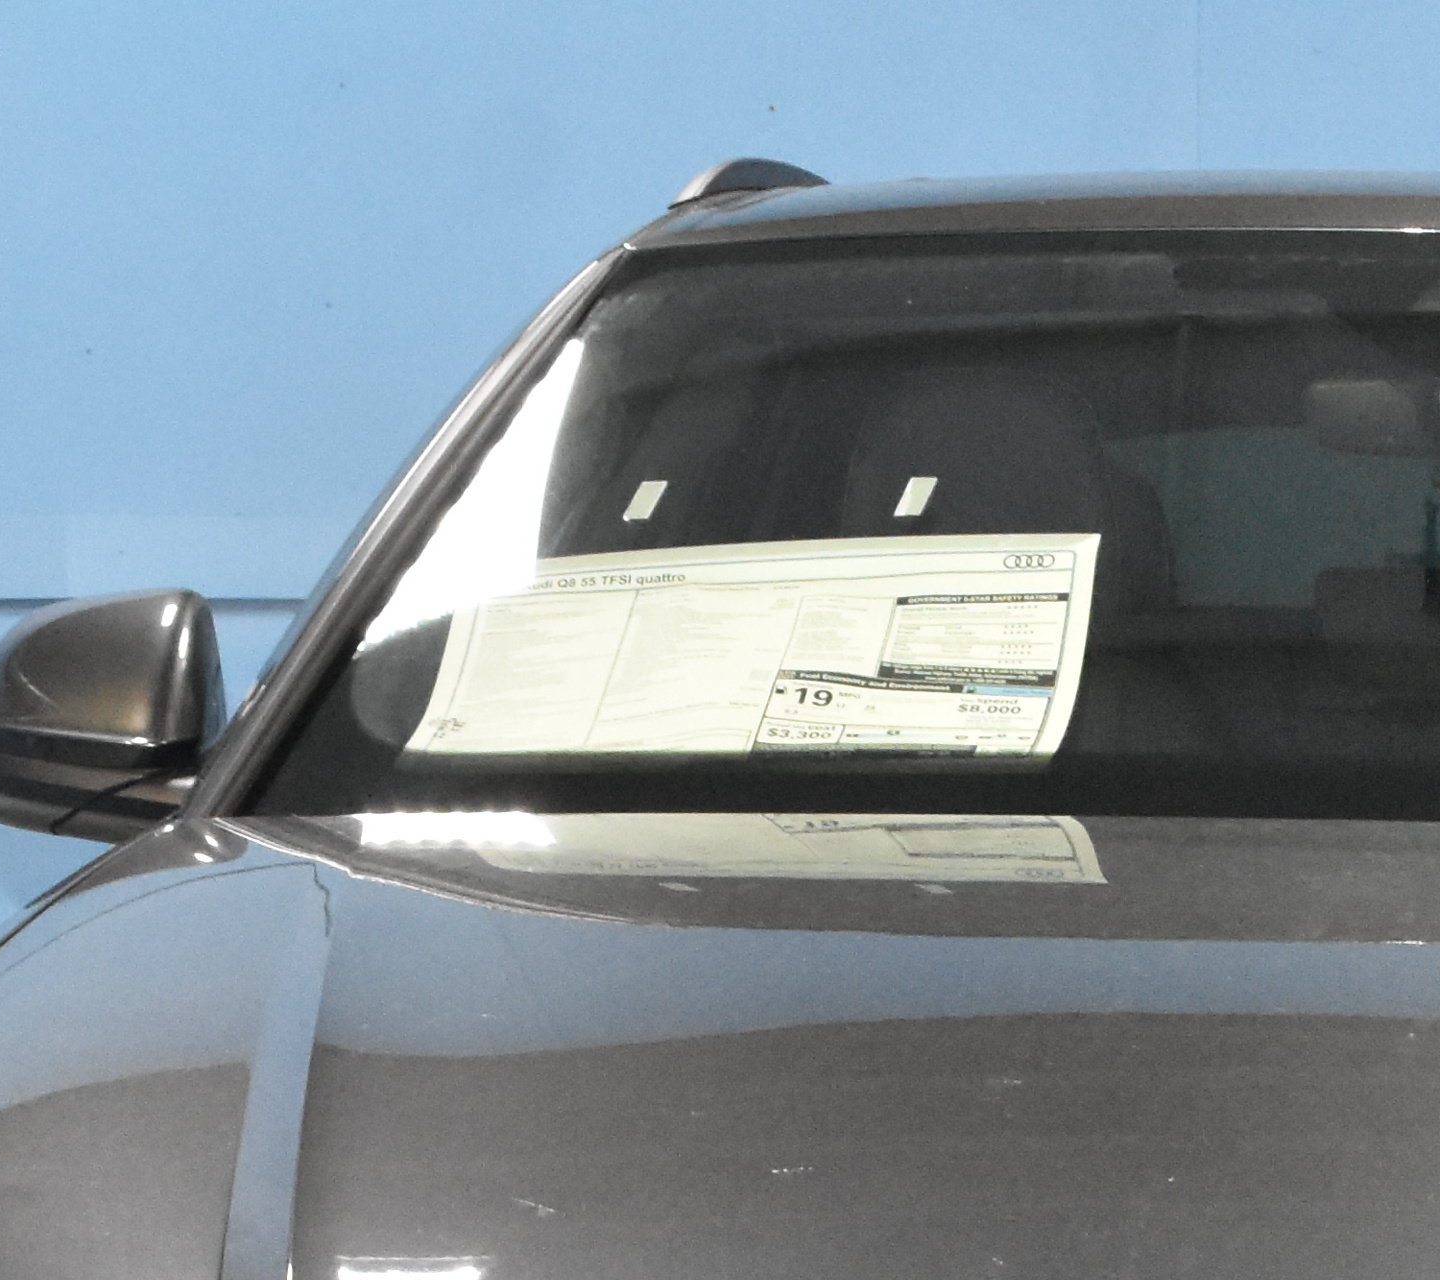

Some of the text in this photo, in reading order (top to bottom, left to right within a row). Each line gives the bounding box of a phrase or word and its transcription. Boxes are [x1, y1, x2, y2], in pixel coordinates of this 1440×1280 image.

[556, 577, 577, 589] Q8
[579, 576, 597, 587] 55
[600, 574, 633, 586] TFSI
[635, 572, 687, 586] quattro
[794, 687, 833, 707] 19
[957, 703, 1022, 715] $8,000
[767, 727, 832, 740] $3,300
